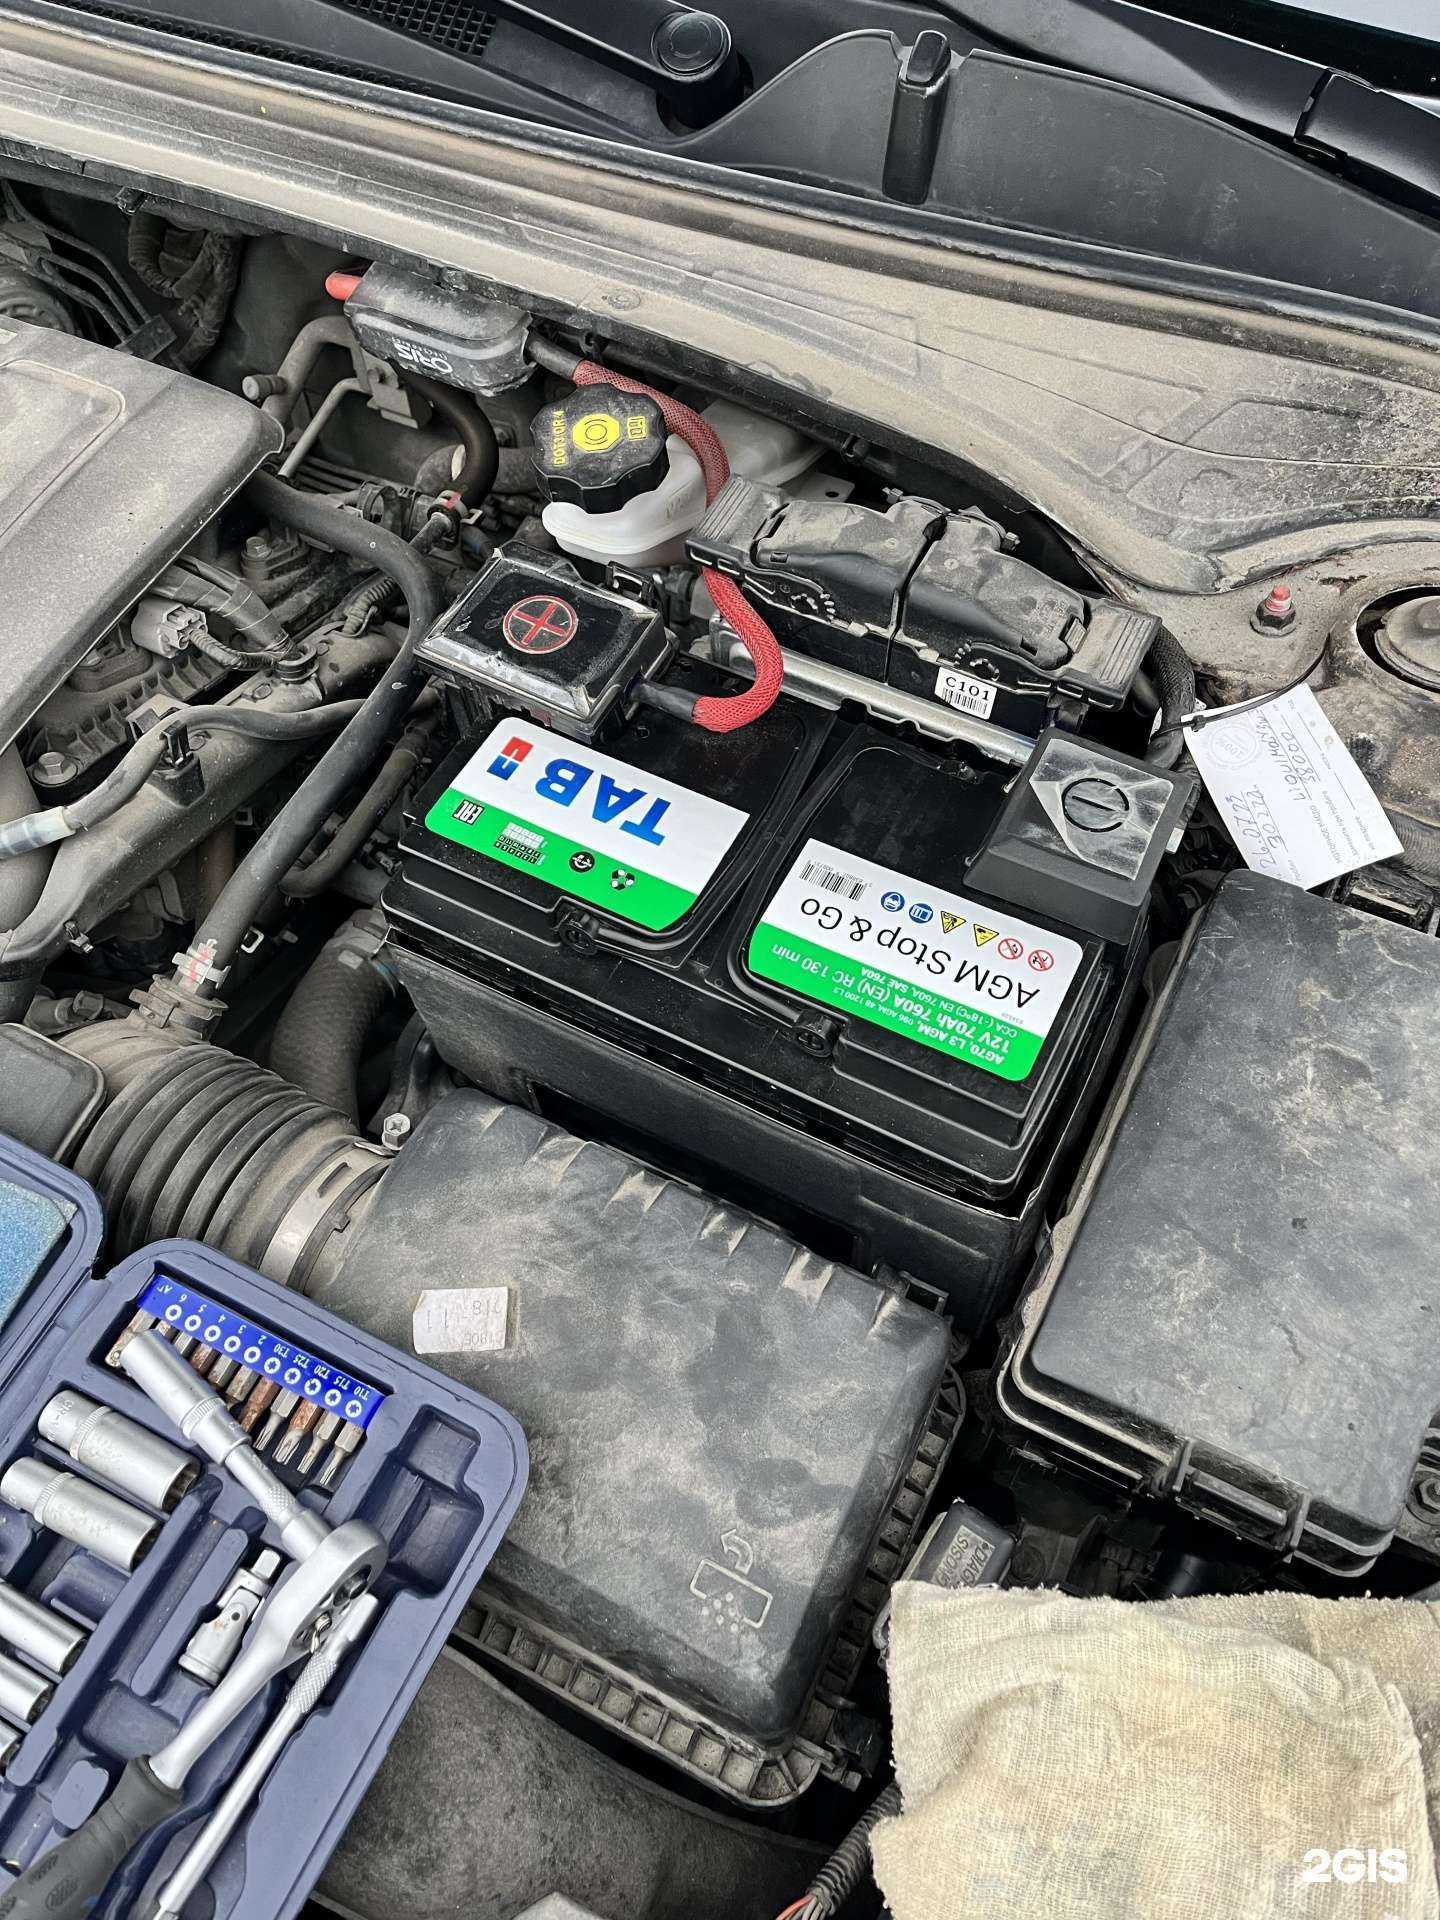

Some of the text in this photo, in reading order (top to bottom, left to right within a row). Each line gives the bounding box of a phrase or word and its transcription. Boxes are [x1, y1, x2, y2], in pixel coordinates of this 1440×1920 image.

[945, 675, 990, 701] C101
[536, 756, 670, 846] TAB
[769, 942, 801, 964] min
[801, 896, 1040, 1007] AGM Stop & Go
[800, 955, 829, 977] 130
[860, 966, 886, 983] 760A
[830, 968, 856, 987] RC
[887, 978, 909, 993] SAE
[856, 977, 891, 1003] (EN)
[892, 993, 932, 1020] 760A
[938, 999, 954, 1012] EN
[933, 1011, 977, 1039] 70Ah
[993, 1022, 1018, 1038] CCA
[977, 1030, 1012, 1053] 12V
[272, 1341, 290, 1357] T30
[291, 1352, 311, 1368] T25
[312, 1363, 331, 1379] T20
[333, 1373, 351, 1389] T15
[352, 1384, 371, 1400] T10
